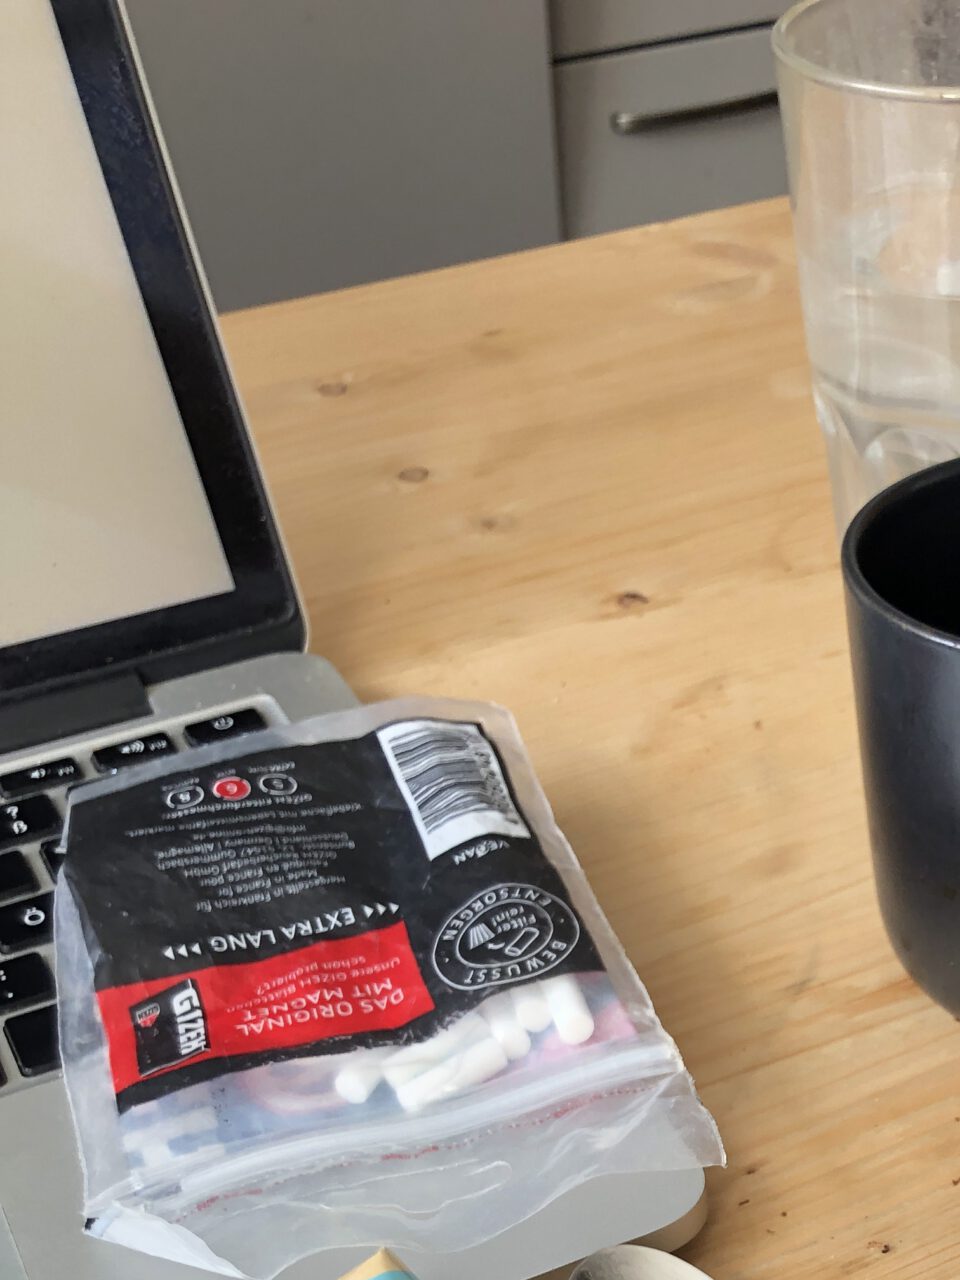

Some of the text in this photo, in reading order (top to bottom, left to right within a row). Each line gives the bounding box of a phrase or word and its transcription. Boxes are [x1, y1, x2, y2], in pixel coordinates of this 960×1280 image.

[209, 906, 357, 953] EXTRA LANG
[442, 888, 552, 941] ENTSORGEN
[497, 912, 537, 934] Filter
[463, 939, 568, 985] BEWUSST
[171, 980, 208, 1056] GIZEH
[237, 987, 405, 1036] DAS ORIGINAL
[243, 977, 393, 1021] MIT MAGNET
